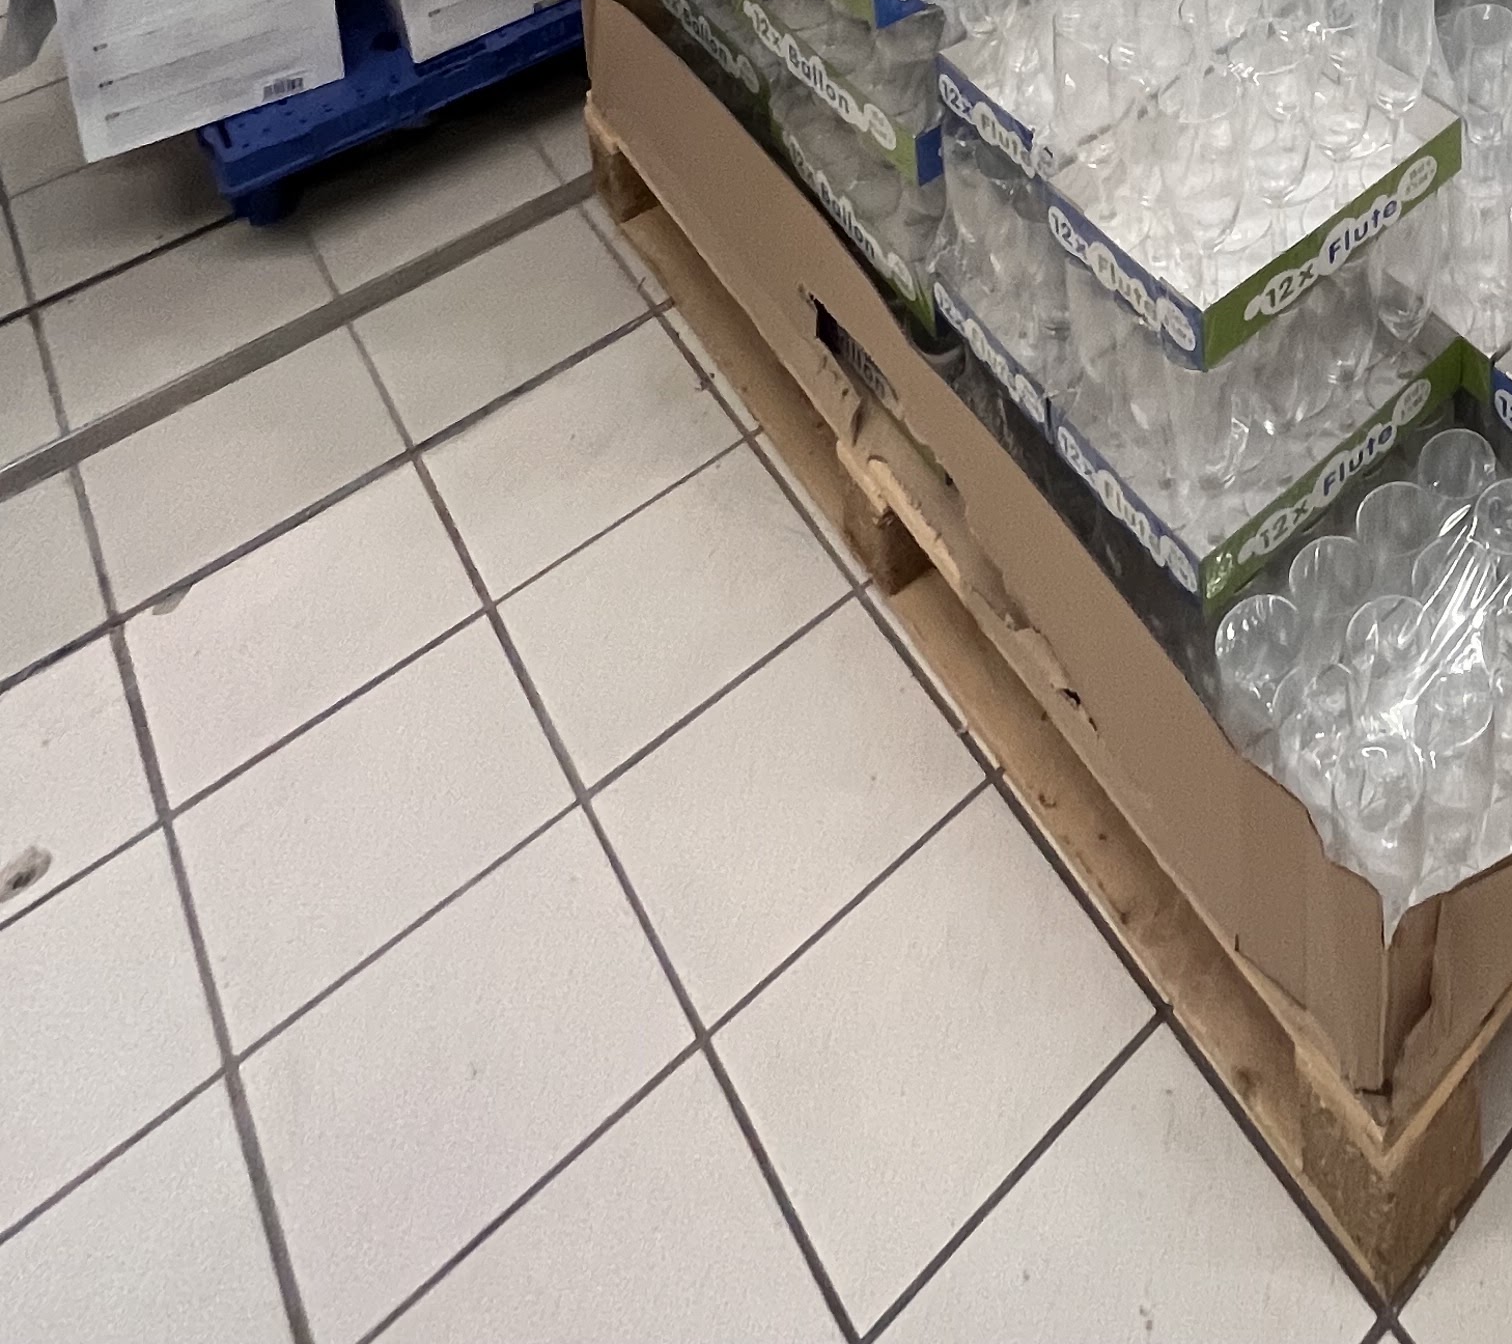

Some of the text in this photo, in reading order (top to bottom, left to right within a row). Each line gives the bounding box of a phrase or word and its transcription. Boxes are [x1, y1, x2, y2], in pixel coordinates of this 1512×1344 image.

[788, 44, 851, 115] Ballon
[1266, 263, 1314, 309] 12x
[1259, 499, 1309, 549] 12x
